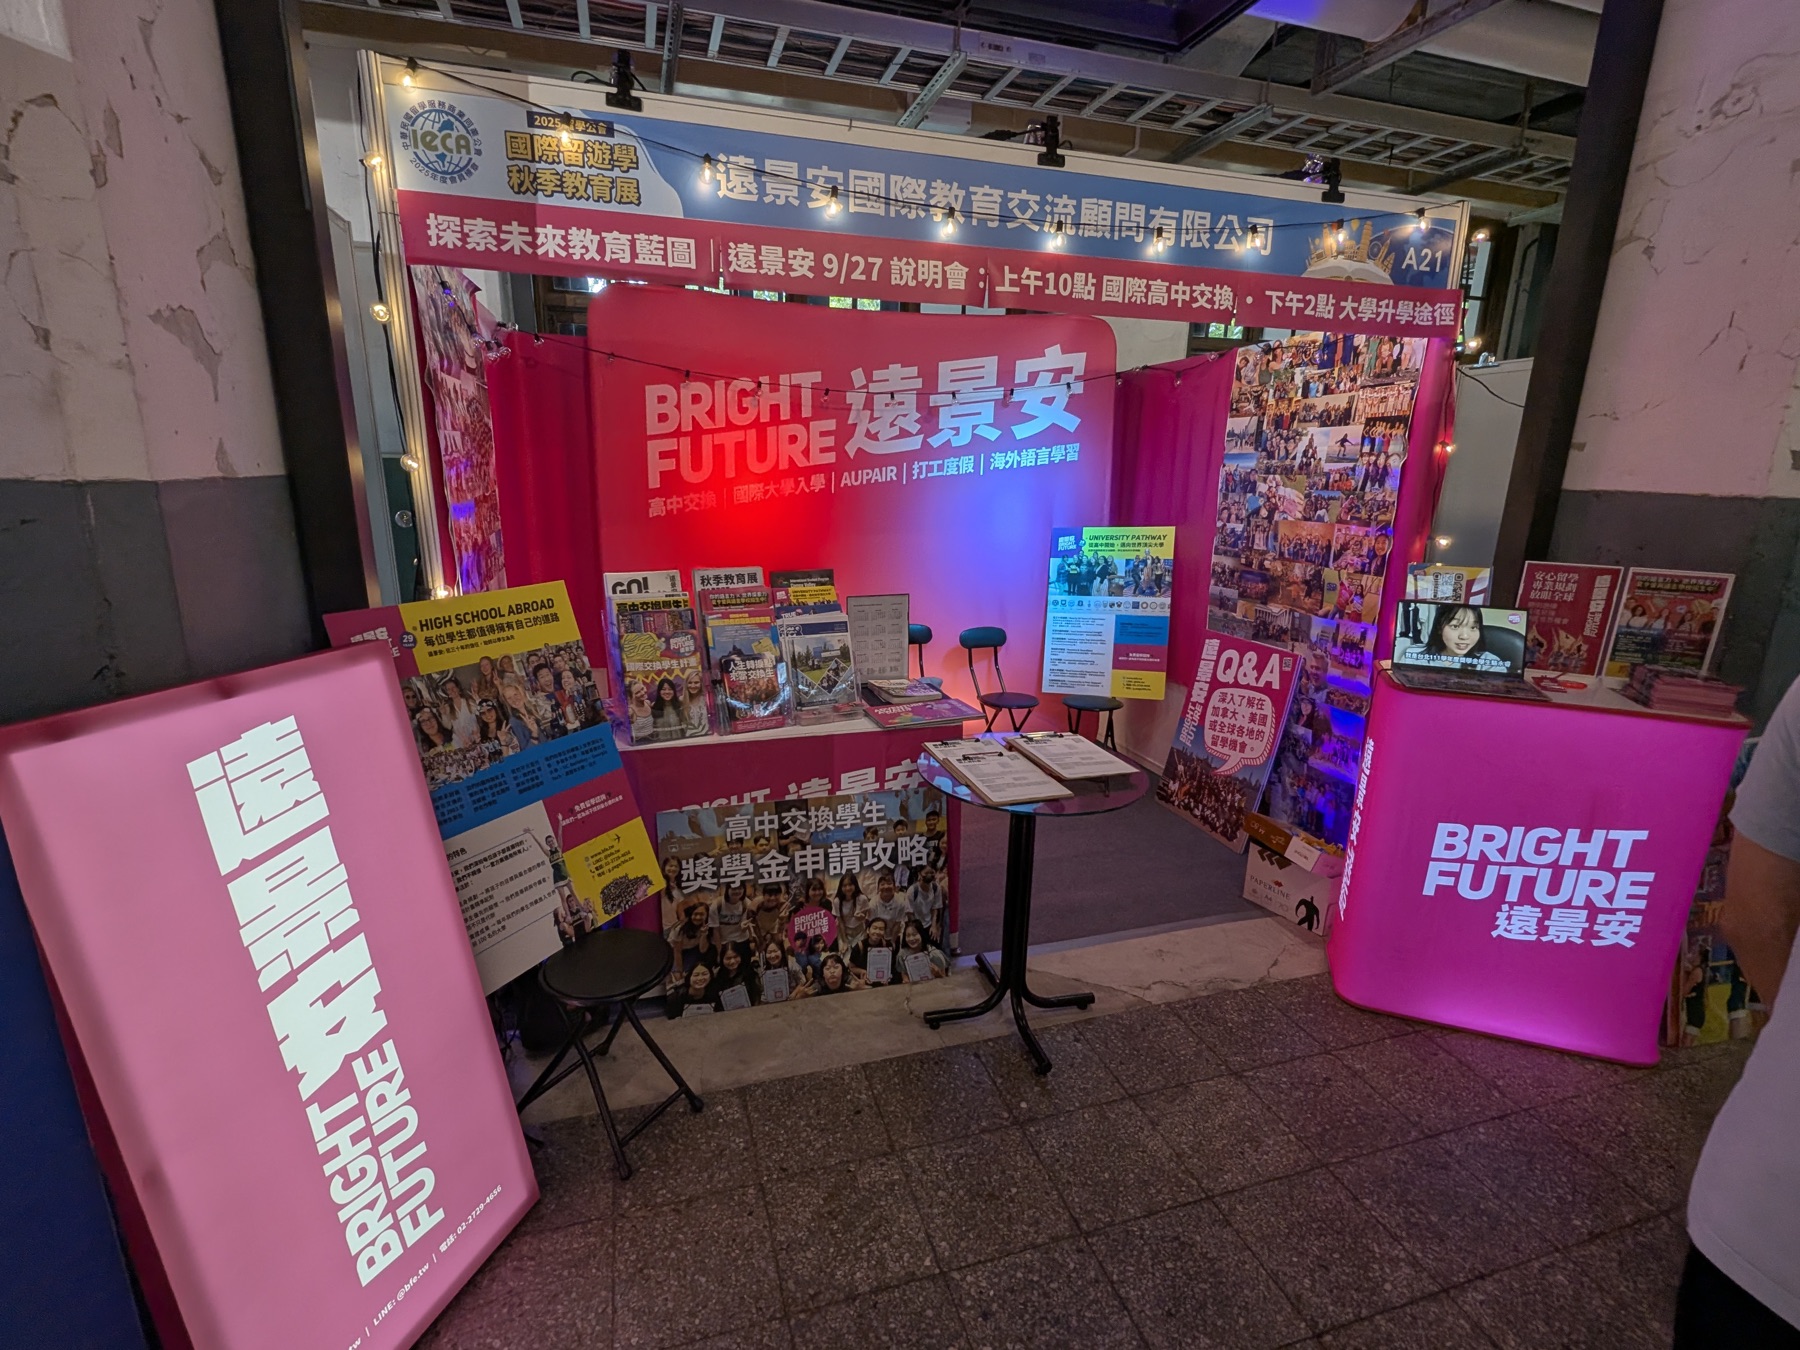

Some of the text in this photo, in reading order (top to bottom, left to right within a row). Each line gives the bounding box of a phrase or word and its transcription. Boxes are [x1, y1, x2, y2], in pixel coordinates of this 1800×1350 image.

[504, 130, 638, 171] 國際留遊學
[506, 164, 642, 206] 秋季教育展
[715, 151, 1274, 256] 遠景安國際教育交流顧問有限公司
[425, 212, 696, 270] 探索未來教育藍圖
[1402, 247, 1444, 274] A21
[728, 241, 816, 279] 遠景安
[822, 251, 882, 283] 9/27
[996, 267, 1095, 301] 上午10點
[1102, 277, 1234, 311] 國際高中交換
[1265, 289, 1334, 320] 下午2點
[1339, 292, 1455, 327] 大學升學途徑
[645, 371, 823, 435] BRIGHT
[844, 343, 1088, 460] 遠景安
[646, 419, 837, 489] FUTURE
[648, 442, 1080, 518] 高中交換 國際大學入學 AUPAIR 打工度假 海外語言學習
[700, 572, 758, 587] 秋季教育展
[1534, 571, 1579, 582] 安心留學
[418, 597, 555, 632] HIGH SCHOOL ABROAD
[424, 611, 560, 648] 每位學生都值得擁有自己的道路
[402, 634, 414, 643] 29
[1216, 649, 1280, 690] Q&A
[1179, 702, 1195, 743] BRIGHT
[1210, 705, 1268, 727] 加拿大、美國
[1217, 692, 1266, 711] 深入了解在
[1185, 703, 1204, 747] FUTURE
[1208, 719, 1265, 742] 或全球各地的
[1210, 734, 1255, 754] 留學機會。
[724, 800, 888, 842] 高中交換學生
[681, 835, 929, 894] 獎學金申請攻略
[1430, 822, 1650, 868] BRIGHT
[1250, 875, 1291, 900] PAPERLINE
[1422, 862, 1655, 910] FUTURE
[186, 714, 389, 1102] 遠景安
[794, 909, 826, 925] BRIGHT
[794, 916, 829, 934] FUTURE
[1491, 903, 1643, 948] 遠景安
[352, 1038, 447, 1249] FUTURE
[305, 1091, 404, 1288] BRIGHT
[373, 1299, 396, 1327] LINE:
[396, 1262, 430, 1302] @bfe.tw
[456, 1184, 503, 1235] 02-2729-4656
